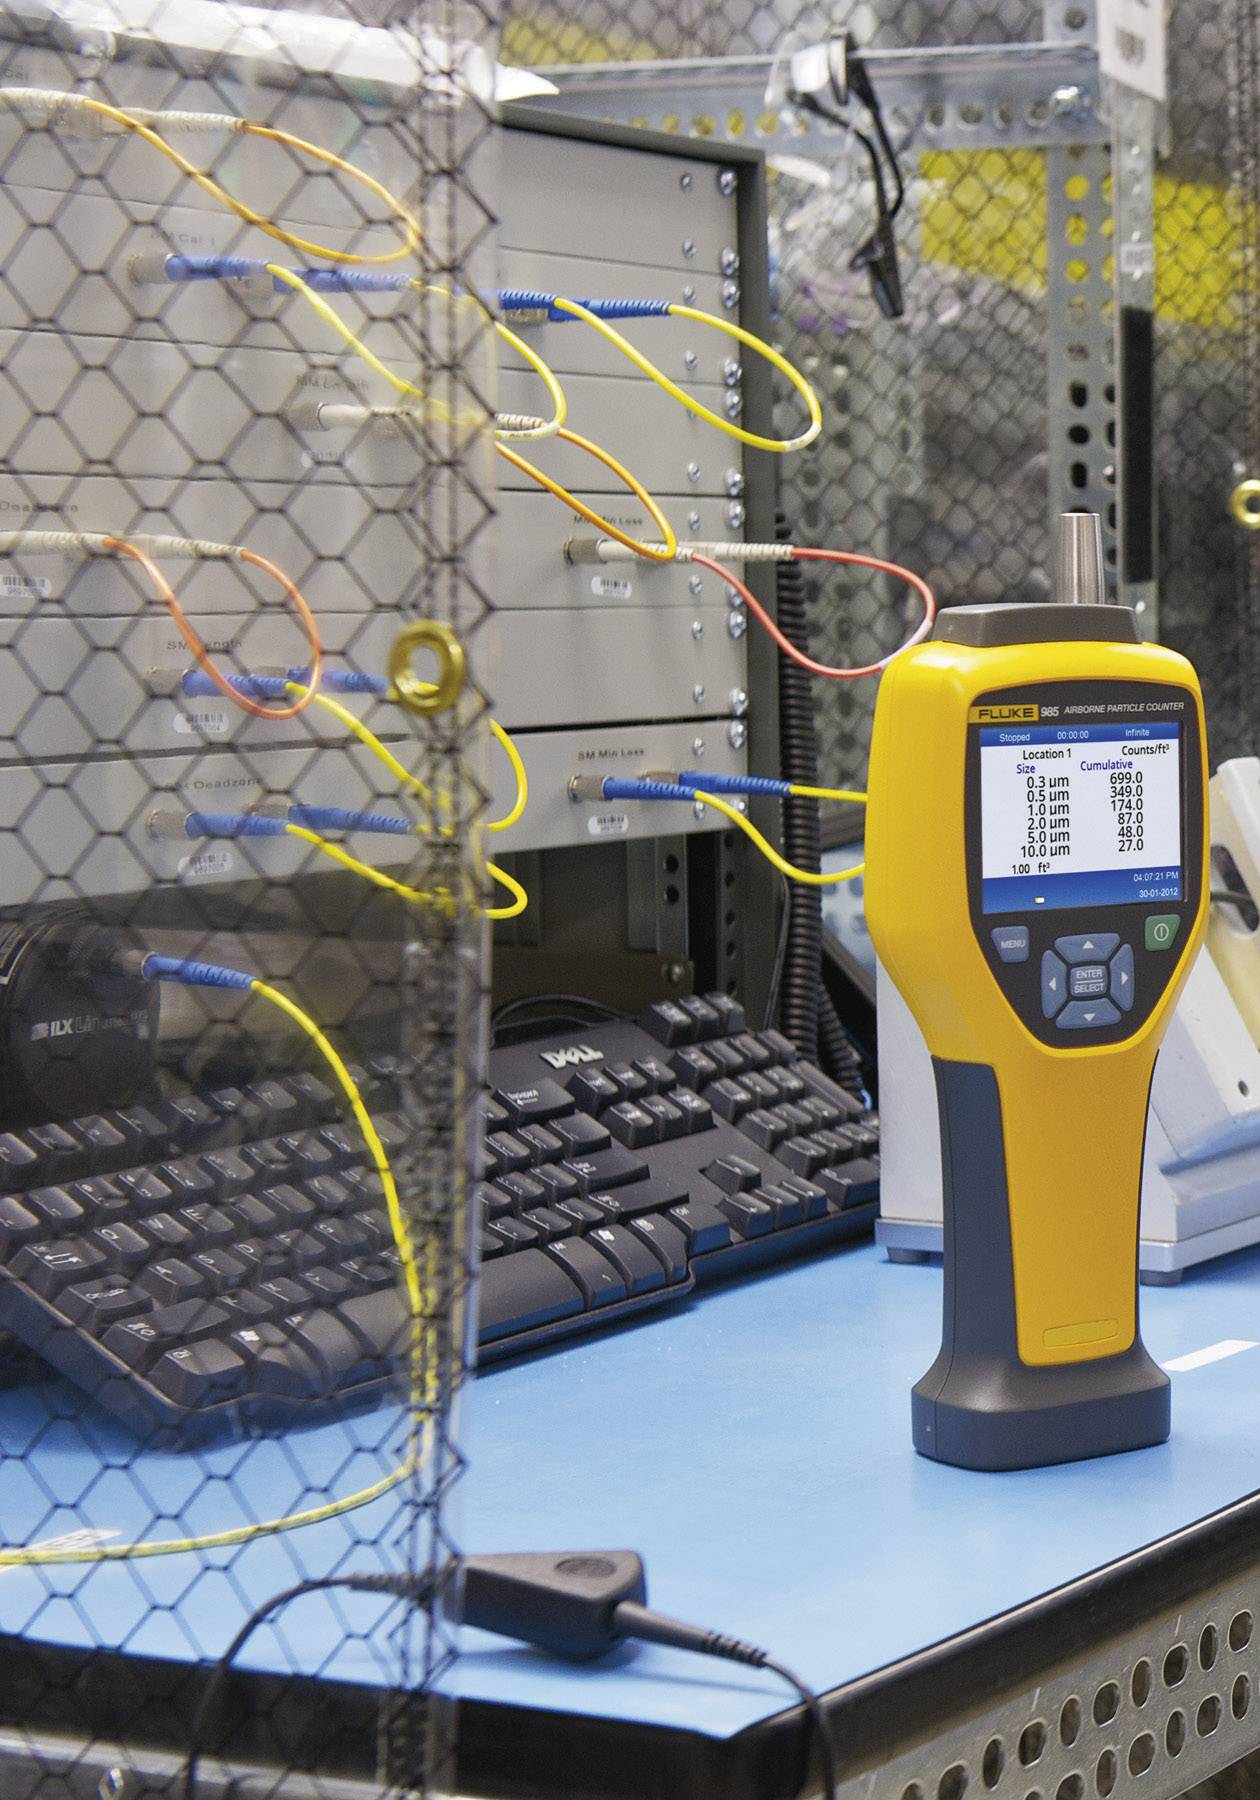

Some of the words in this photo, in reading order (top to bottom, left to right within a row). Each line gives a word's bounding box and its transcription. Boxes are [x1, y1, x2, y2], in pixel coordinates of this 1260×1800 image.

[978, 708, 1034, 719] FLUKE
[1040, 706, 1060, 717] 985
[1063, 705, 1105, 714] AIRBORNE
[1107, 703, 1145, 713] PARTICLE
[1146, 702, 1185, 711] COUNTER
[999, 733, 1031, 743] Stopped
[1057, 730, 1089, 740] 00:00:00
[1125, 728, 1150, 737] Infinite
[1023, 748, 1064, 760] Location
[1067, 748, 1072, 758] 1
[1016, 763, 1036, 774] Size
[1080, 759, 1133, 771] Cumulative
[1026, 776, 1046, 789] 0.3
[1110, 771, 1143, 785] 699.0
[1027, 790, 1046, 803] 0.5
[1110, 785, 1143, 798] 349.0
[1028, 804, 1046, 816] 1.0
[1111, 799, 1143, 811] 174.0
[1027, 817, 1046, 830] 2.0
[1118, 812, 1144, 825] 87.0
[1028, 831, 1047, 844] 5.0
[1118, 825, 1144, 838] 48.0
[1021, 845, 1047, 858] 10.0
[1118, 839, 1144, 852] 27.0
[1012, 864, 1030, 875] 1.00
[1038, 862, 1050, 873] ft³
[1133, 873, 1164, 882] 04:07:21
[1166, 872, 1179, 880] PM
[1139, 888, 1178, 898] 30-01-2012
[1000, 939, 1026, 949] MENU
[1075, 968, 1103, 979] ENTER
[1074, 983, 1105, 993] SELECT
[539, 1044, 605, 1070] DELL
